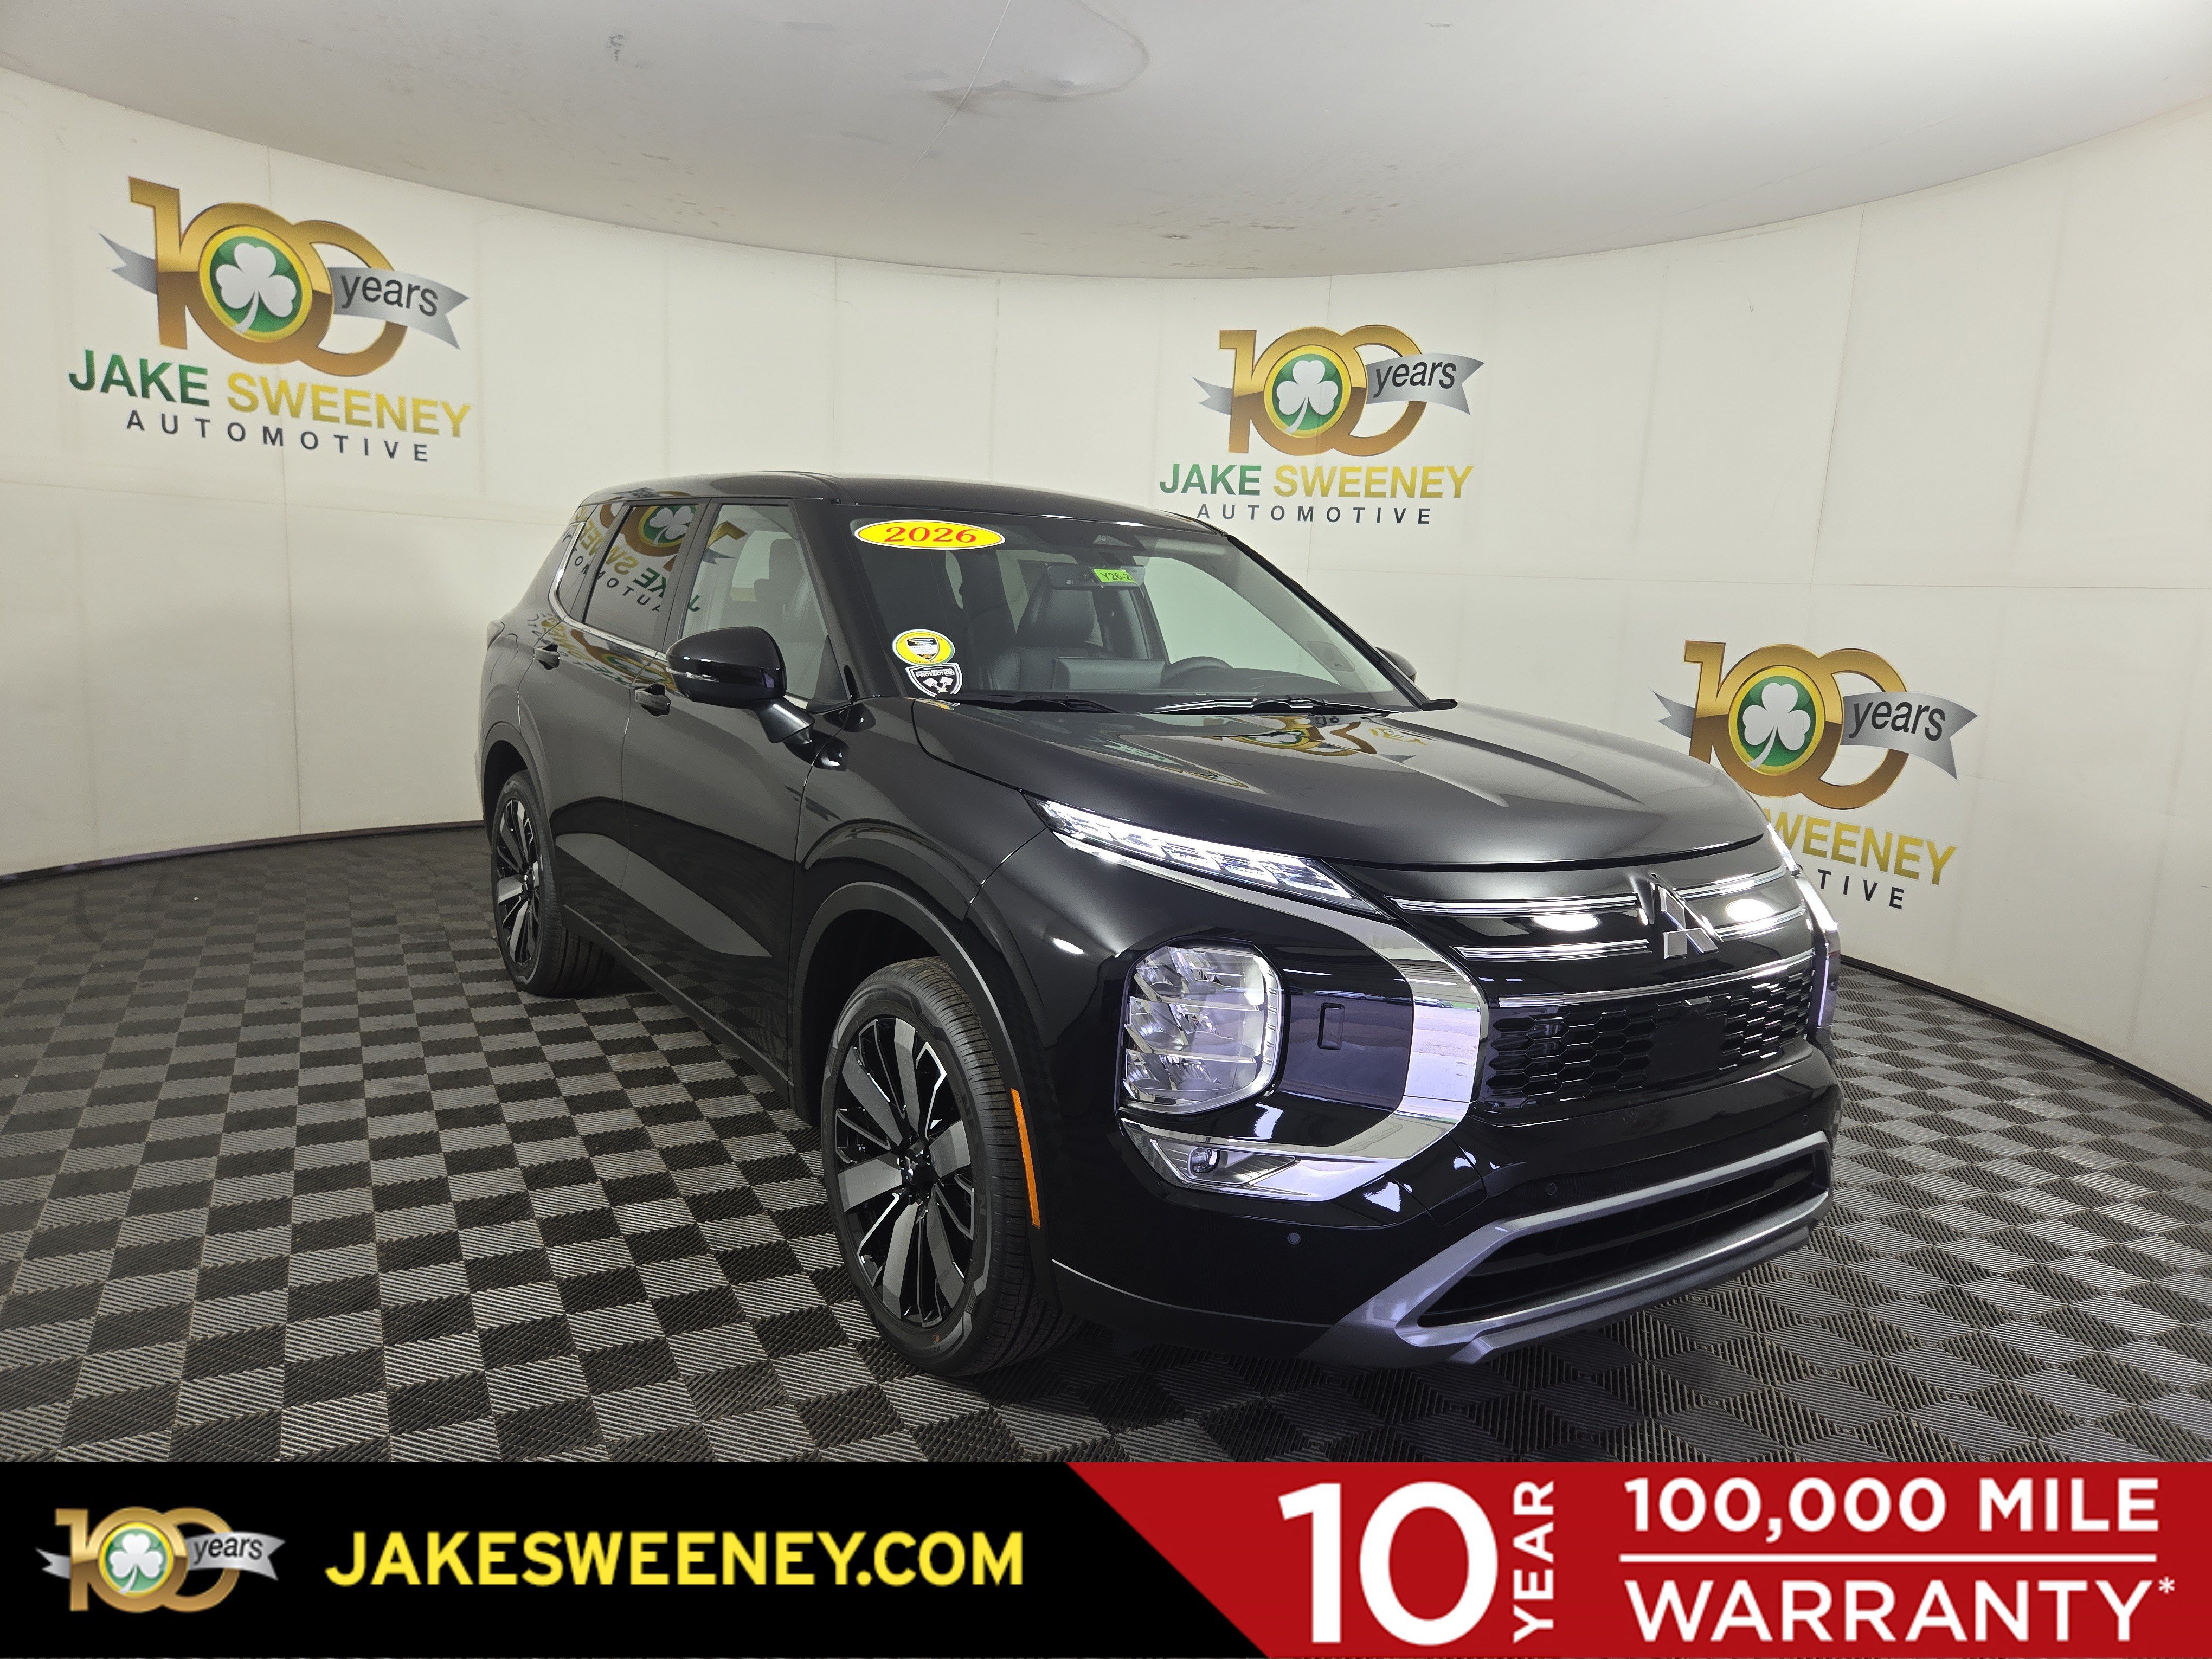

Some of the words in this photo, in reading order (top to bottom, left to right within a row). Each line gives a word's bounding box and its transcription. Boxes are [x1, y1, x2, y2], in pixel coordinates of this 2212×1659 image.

[128, 176, 408, 377] 100
[340, 274, 438, 317] years
[68, 349, 210, 407] JAKE
[227, 372, 472, 438] SWEENEY
[1219, 324, 1427, 457] 100
[1373, 360, 1457, 398] years
[126, 410, 428, 462] AUTOMOTIVE
[1160, 463, 1262, 496] JAKE
[1274, 465, 1474, 499] SWEENEY
[884, 526, 978, 543] 2026
[1197, 503, 1431, 524] AUTOMOTIVE
[1849, 700, 1946, 741] years
[1764, 808, 1958, 885] WEENEY
